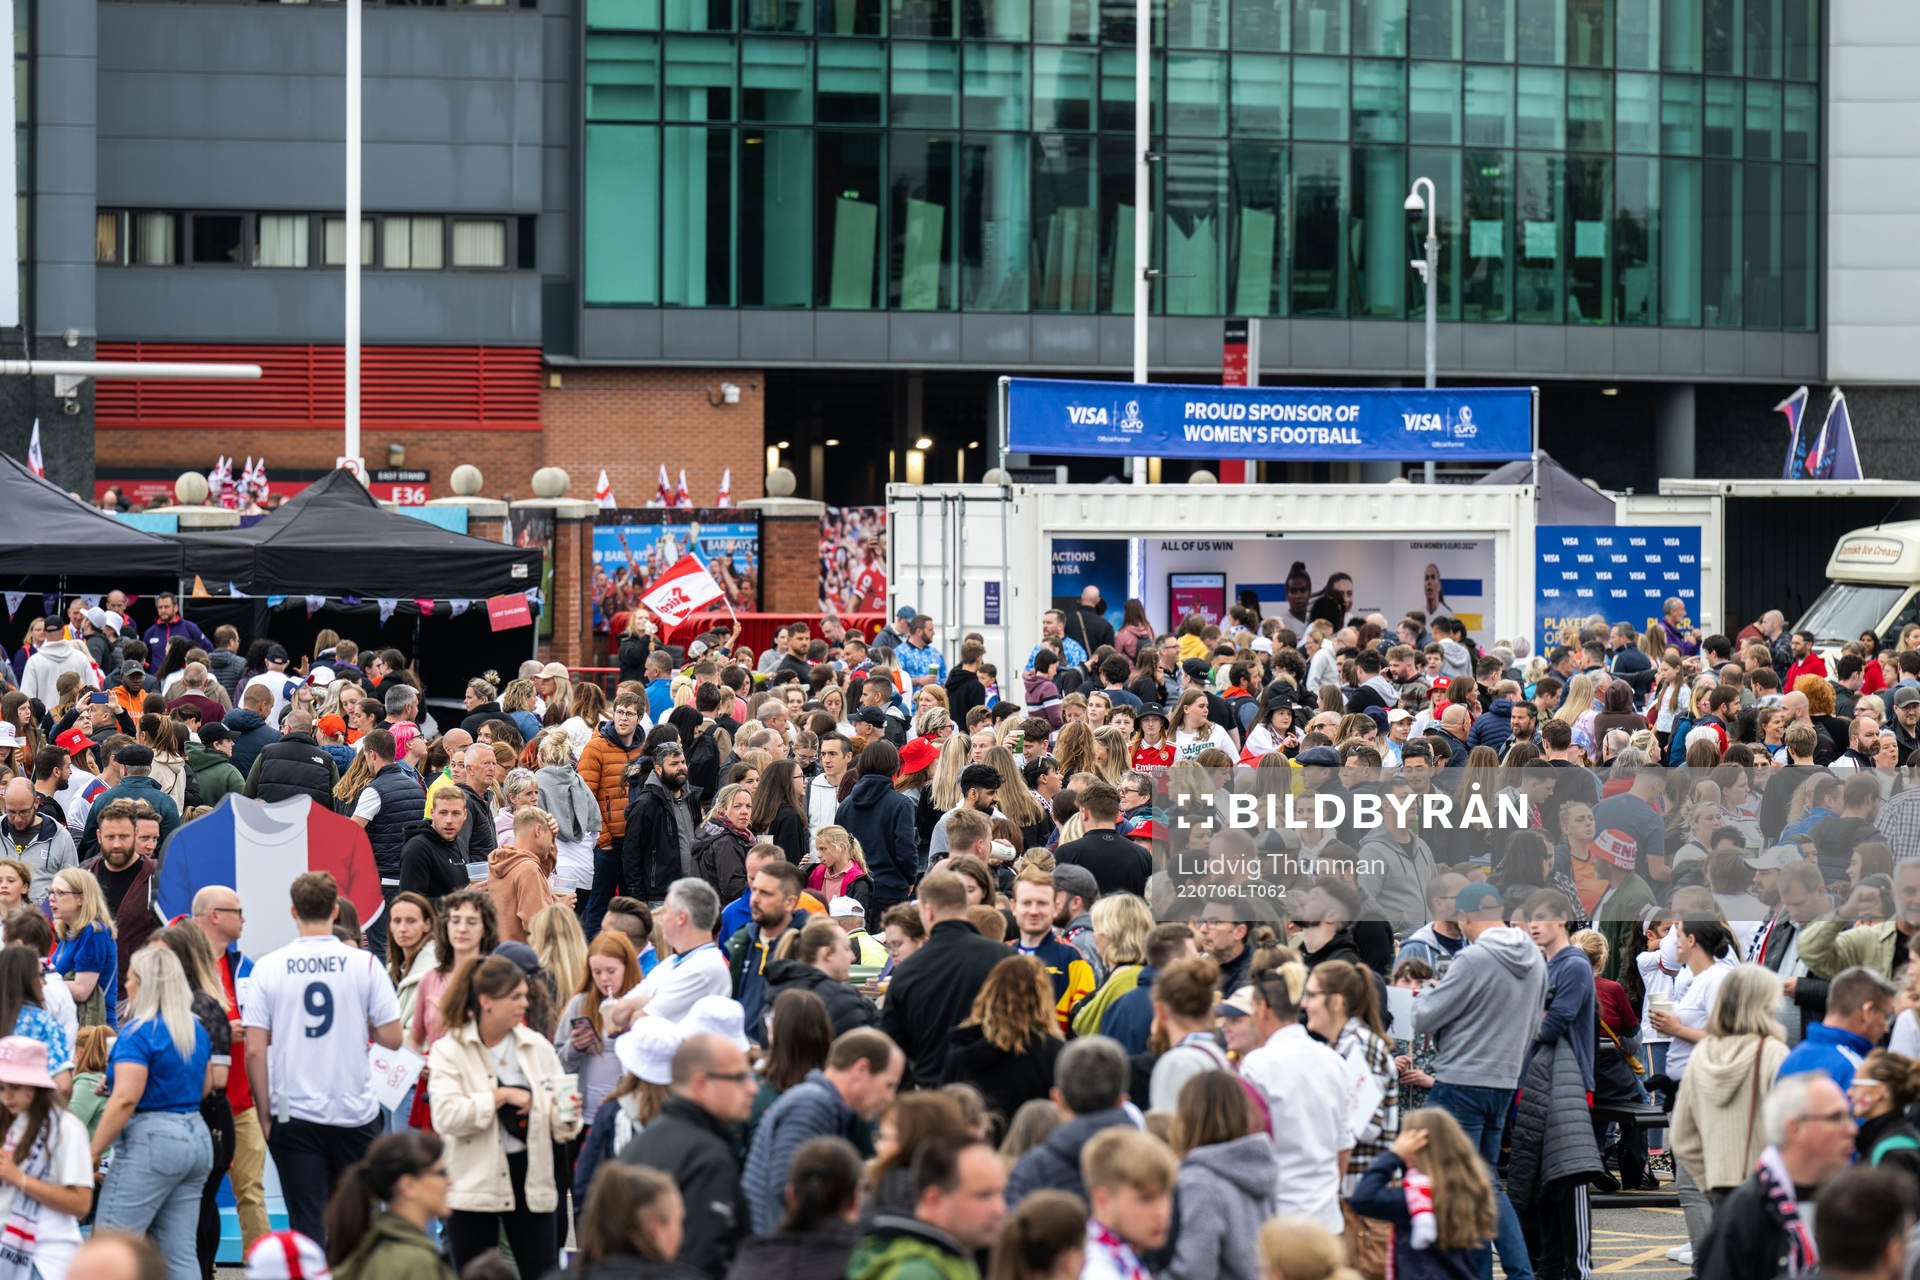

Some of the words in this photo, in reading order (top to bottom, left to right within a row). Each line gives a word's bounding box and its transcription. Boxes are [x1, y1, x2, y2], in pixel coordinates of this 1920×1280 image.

[1066, 406, 1108, 425] VISA
[1184, 402, 1246, 420] PROUD
[1248, 403, 1333, 422] SPONSOR
[1335, 405, 1361, 422] OF
[1401, 413, 1442, 431] VISA
[1183, 424, 1268, 443] WOMEN'S
[1270, 427, 1362, 445] FOOTBALL
[391, 486, 426, 505] E36
[1161, 541, 1180, 551] ALL
[1181, 541, 1195, 551] OF
[1197, 541, 1211, 551] US
[1212, 541, 1234, 551] WIN
[1562, 537, 1579, 546] VISA
[1596, 537, 1612, 546] VISA
[1630, 537, 1646, 546] VISA
[1663, 537, 1680, 546] VISA
[1543, 554, 1560, 563] VISA
[1577, 554, 1594, 563] VISA
[1611, 554, 1627, 563] VISA
[1645, 554, 1661, 563] VISA
[1679, 554, 1695, 563] VISA
[1057, 565, 1080, 575] VISA
[1562, 571, 1578, 580] VISA
[1596, 571, 1612, 580] VISA
[1629, 571, 1646, 580] VISA
[1663, 571, 1679, 580] VISA
[1543, 589, 1560, 598] VISA
[1577, 589, 1593, 598] VISA
[1611, 589, 1627, 598] VISA
[1644, 589, 1661, 598] VISA
[1678, 589, 1694, 598] VISA
[1135, 763, 1168, 772] Emirates
[287, 956, 348, 974] ROONEY
[303, 980, 335, 1039] 9
